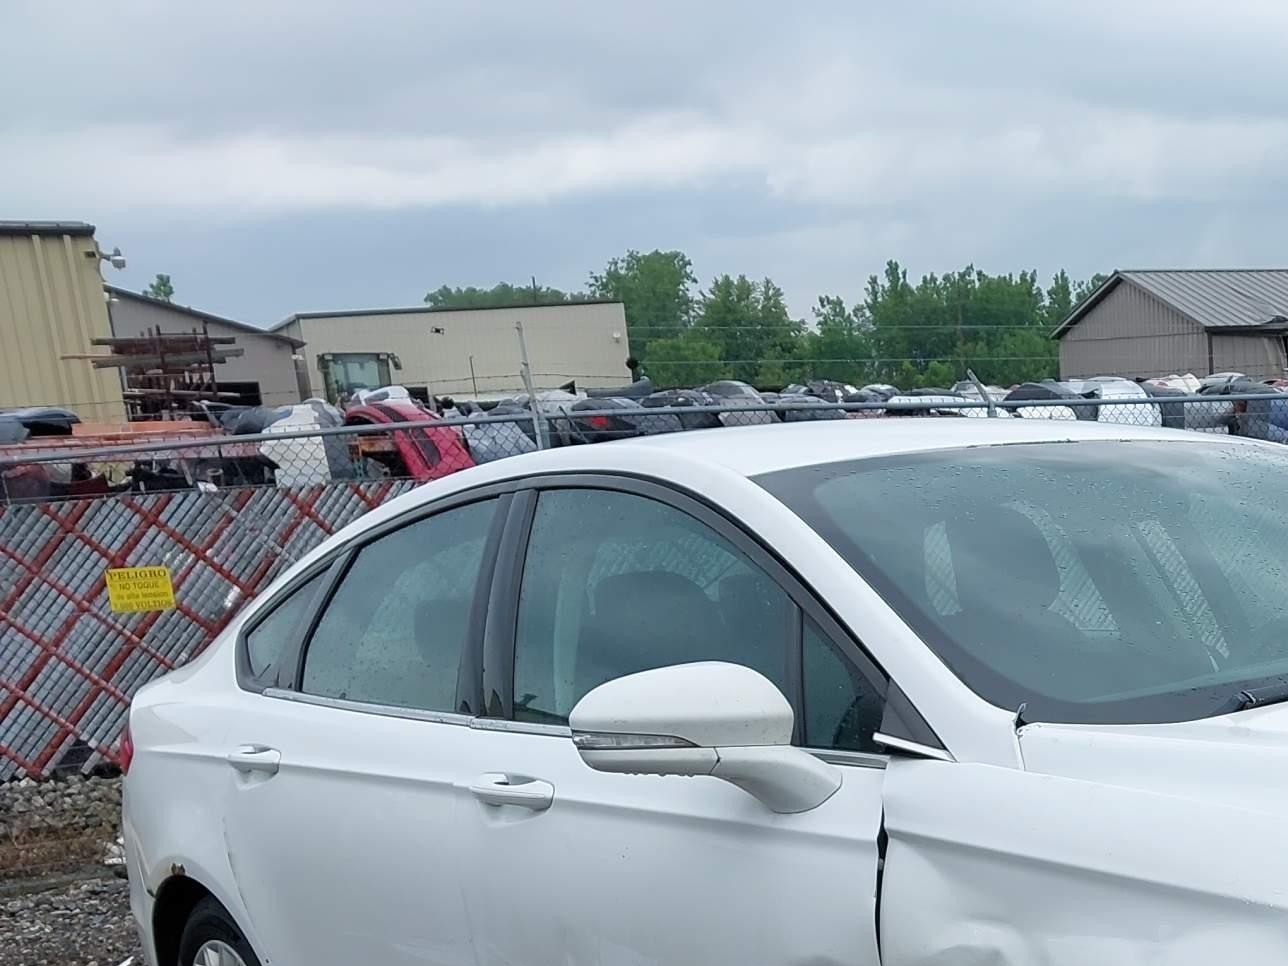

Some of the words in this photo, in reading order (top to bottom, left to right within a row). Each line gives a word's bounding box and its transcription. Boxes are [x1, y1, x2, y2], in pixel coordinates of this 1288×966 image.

[109, 569, 166, 580] PELIGRO
[119, 583, 131, 591] NO
[133, 582, 160, 590] TOQUE
